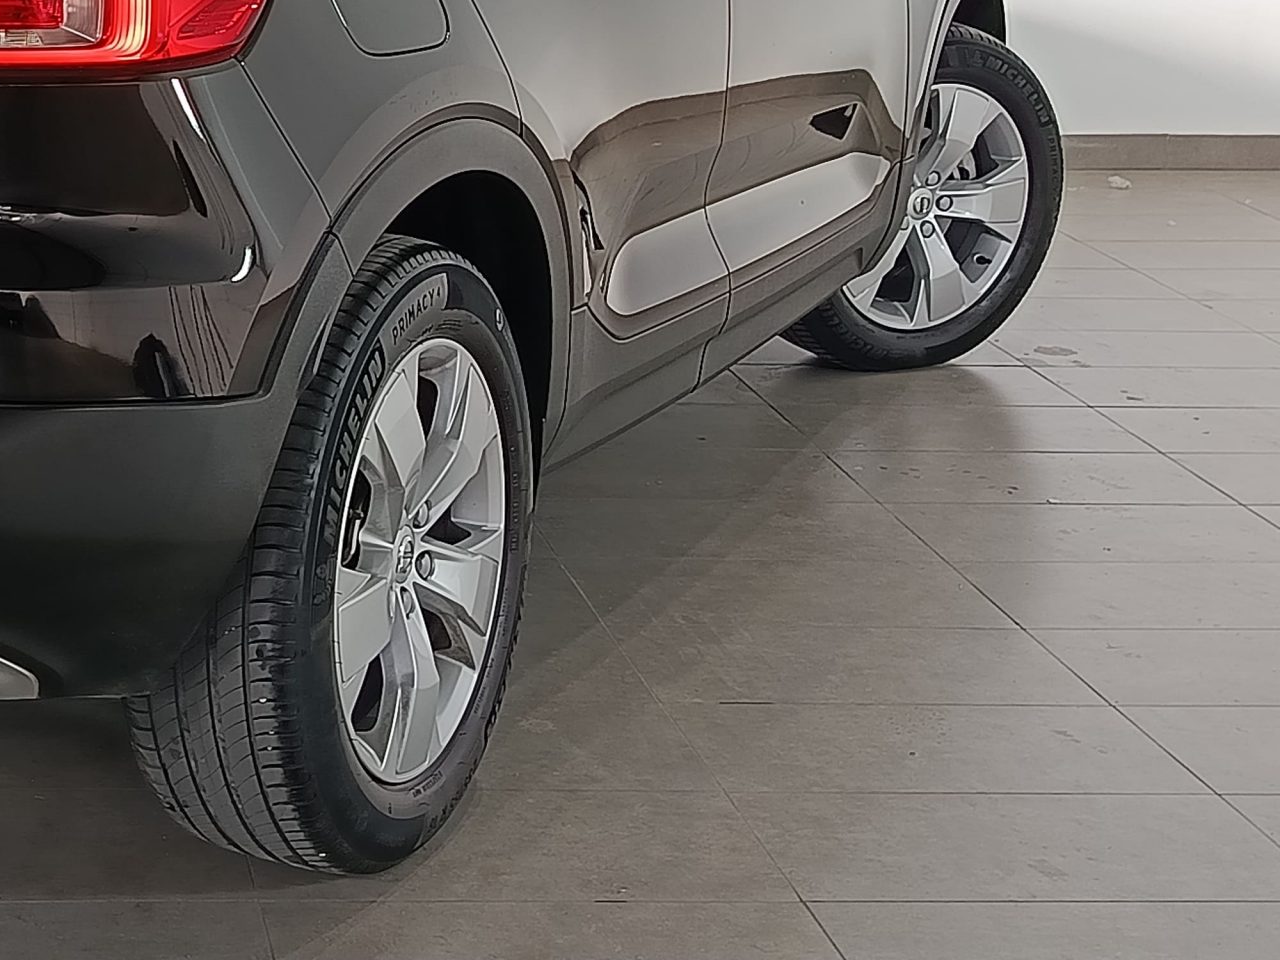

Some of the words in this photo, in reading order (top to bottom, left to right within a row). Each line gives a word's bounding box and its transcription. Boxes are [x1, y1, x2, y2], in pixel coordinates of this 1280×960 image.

[985, 53, 1052, 127] MICHELIN
[391, 287, 435, 346] PRIMACY
[322, 350, 384, 548] MICHELIN
